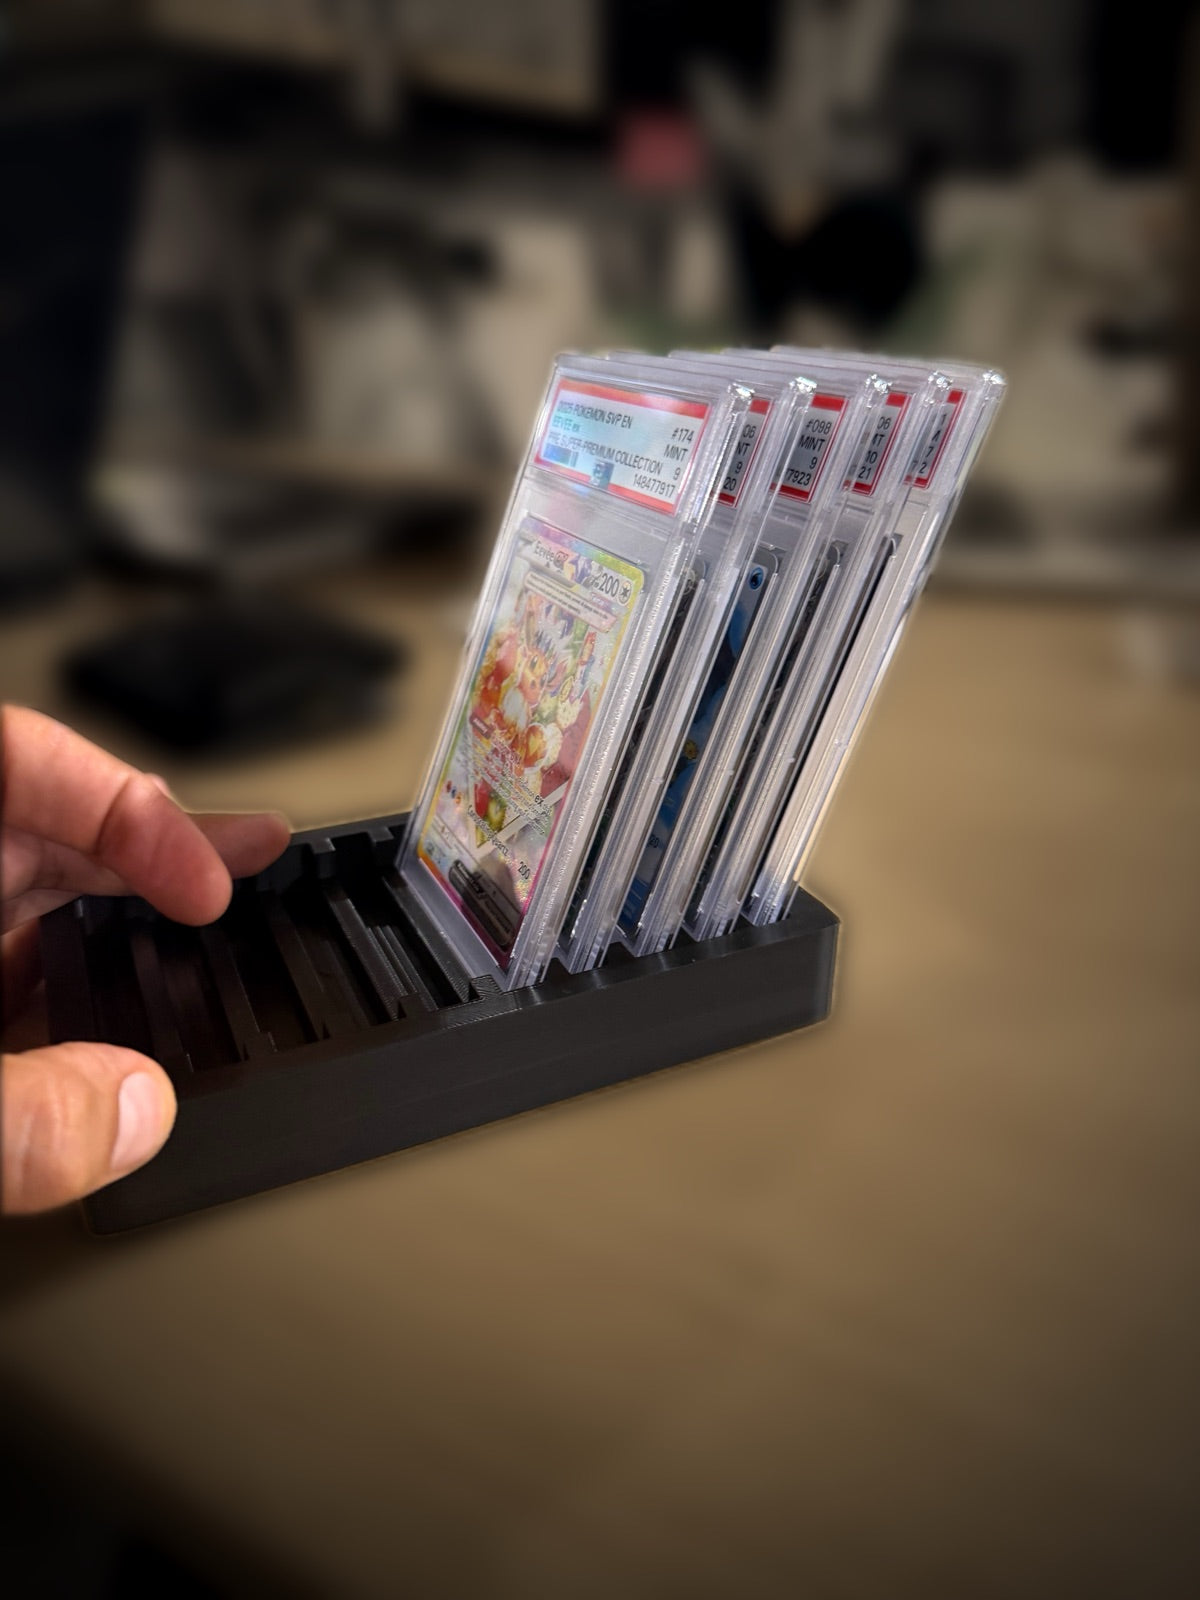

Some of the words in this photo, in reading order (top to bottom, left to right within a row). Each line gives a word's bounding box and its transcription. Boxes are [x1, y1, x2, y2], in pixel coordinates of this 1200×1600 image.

[573, 404, 606, 424] POKEMON
[605, 411, 622, 426] SVP
[621, 415, 633, 429] EN
[877, 416, 891, 430] 06
[671, 428, 695, 444] #174
[743, 424, 757, 439] 06
[736, 442, 751, 457] NT
[798, 435, 826, 452] MINT
[664, 444, 689, 462] MINT
[865, 450, 878, 464] 10
[614, 451, 663, 475] COLLECTION
[735, 461, 743, 474] 9
[809, 456, 818, 470] 9
[673, 467, 682, 481] 9
[786, 467, 812, 486] 7923
[858, 466, 872, 480] 21
[633, 474, 676, 499] 148477917
[723, 476, 737, 491] 20
[599, 572, 620, 598] 200
